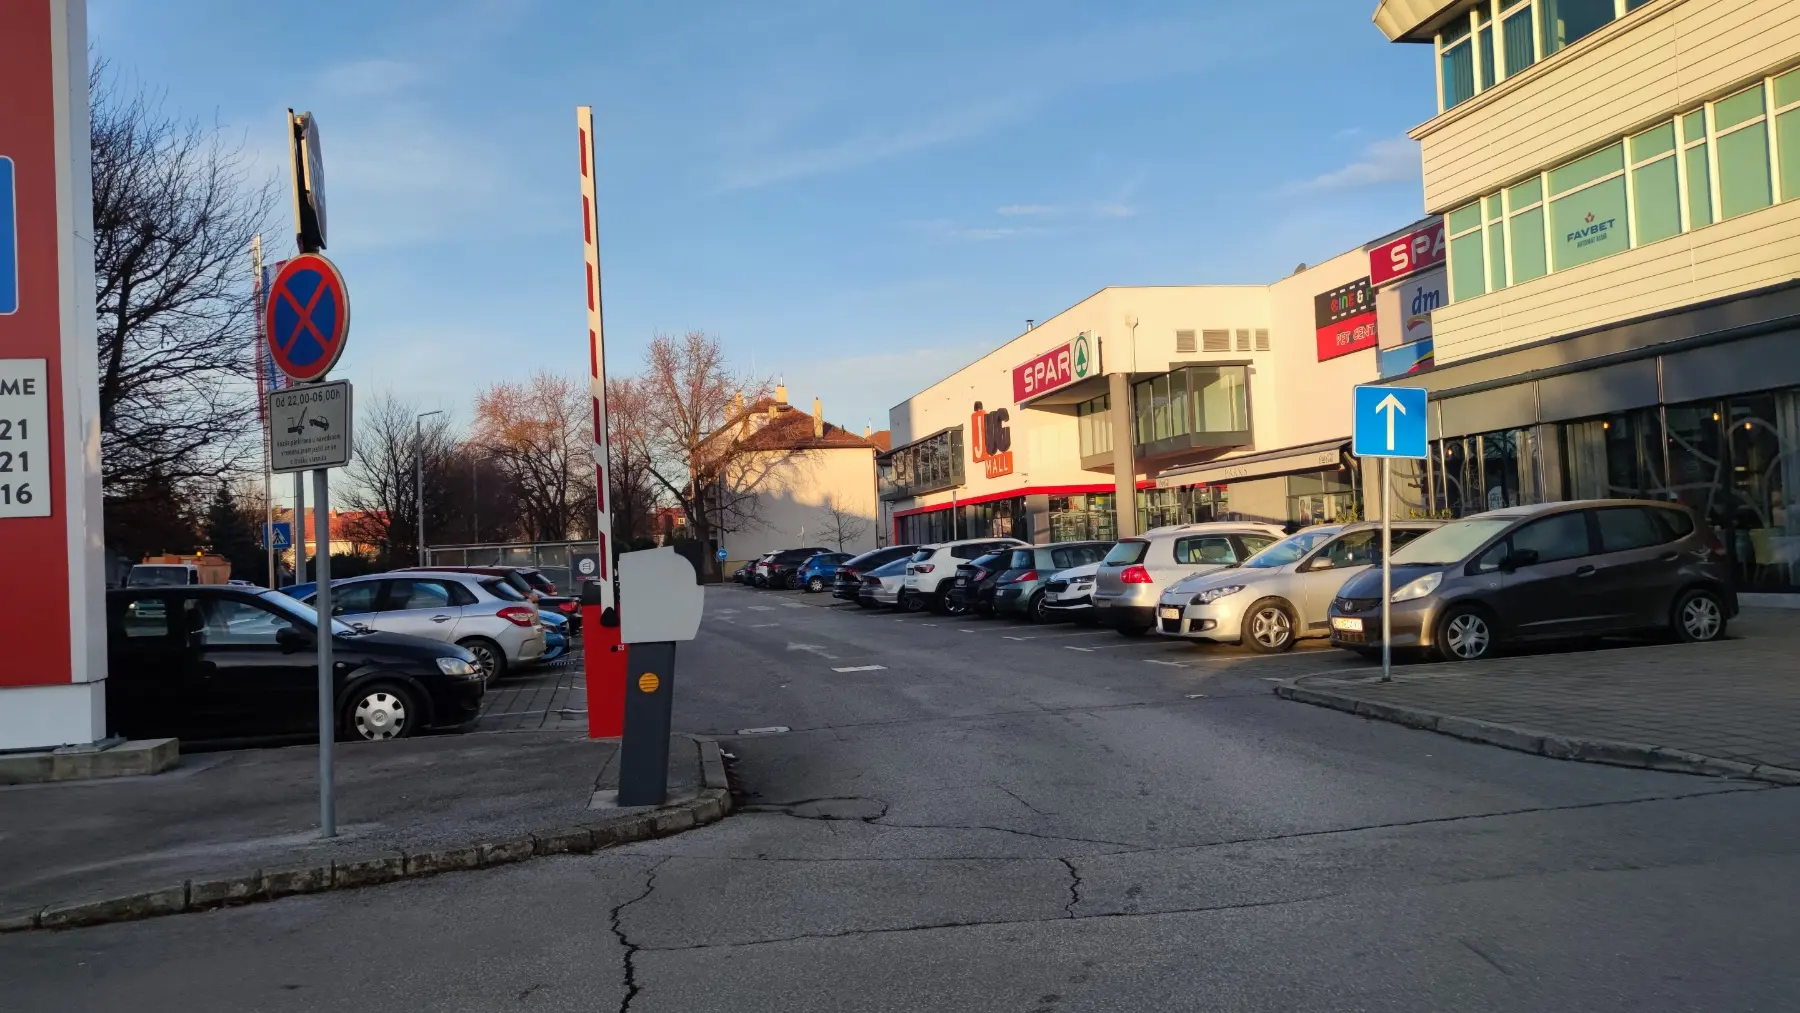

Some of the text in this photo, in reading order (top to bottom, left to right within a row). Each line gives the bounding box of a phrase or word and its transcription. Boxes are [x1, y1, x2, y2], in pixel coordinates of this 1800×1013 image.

[1567, 218, 1615, 243] FAVBET
[1356, 289, 1364, 304] &
[1411, 286, 1440, 316] dm
[1336, 330, 1351, 347] PET
[1023, 350, 1071, 393] SPAR
[972, 403, 1011, 461] JUG
[985, 456, 1009, 475] MALL
[0, 482, 33, 505] 16
